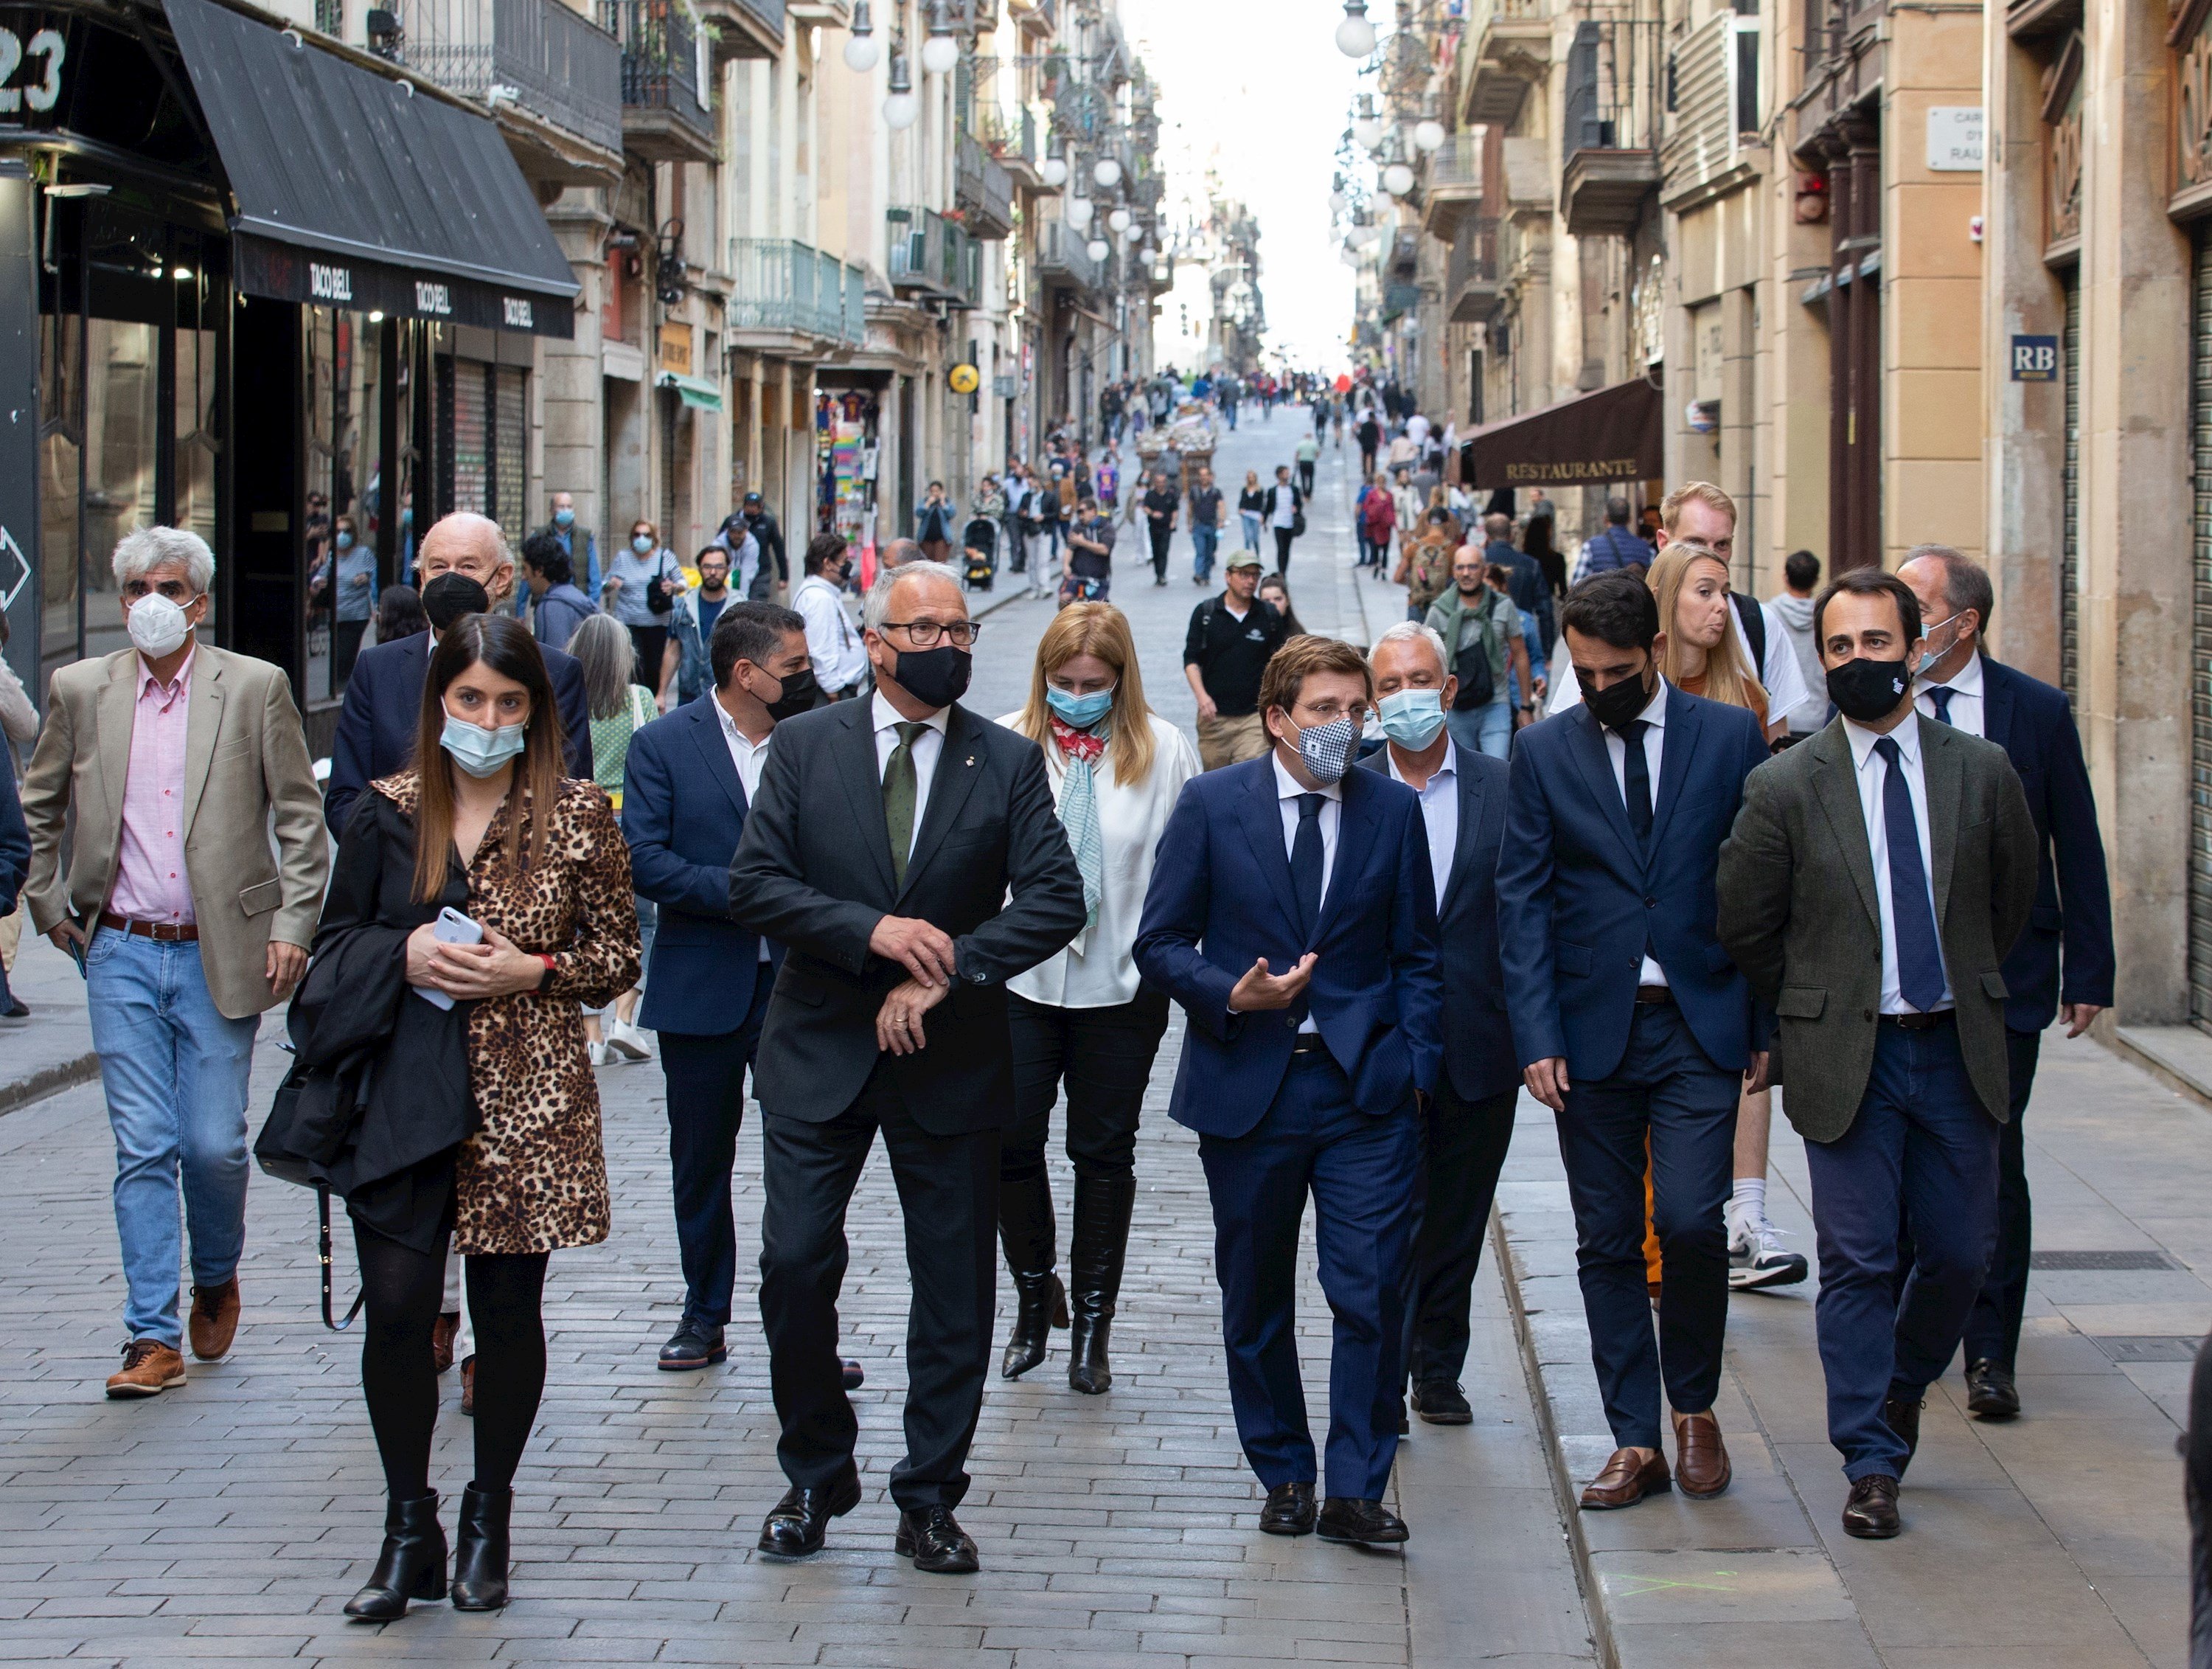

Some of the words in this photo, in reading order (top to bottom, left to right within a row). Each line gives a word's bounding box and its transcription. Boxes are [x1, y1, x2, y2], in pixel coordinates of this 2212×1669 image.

[310, 263, 332, 299] TACO
[332, 267, 352, 301] BELL
[415, 281, 435, 313] TACO
[434, 284, 452, 315] BELL
[2014, 345, 2054, 370] RB
[1506, 455, 1638, 479] RESTAURANTE
